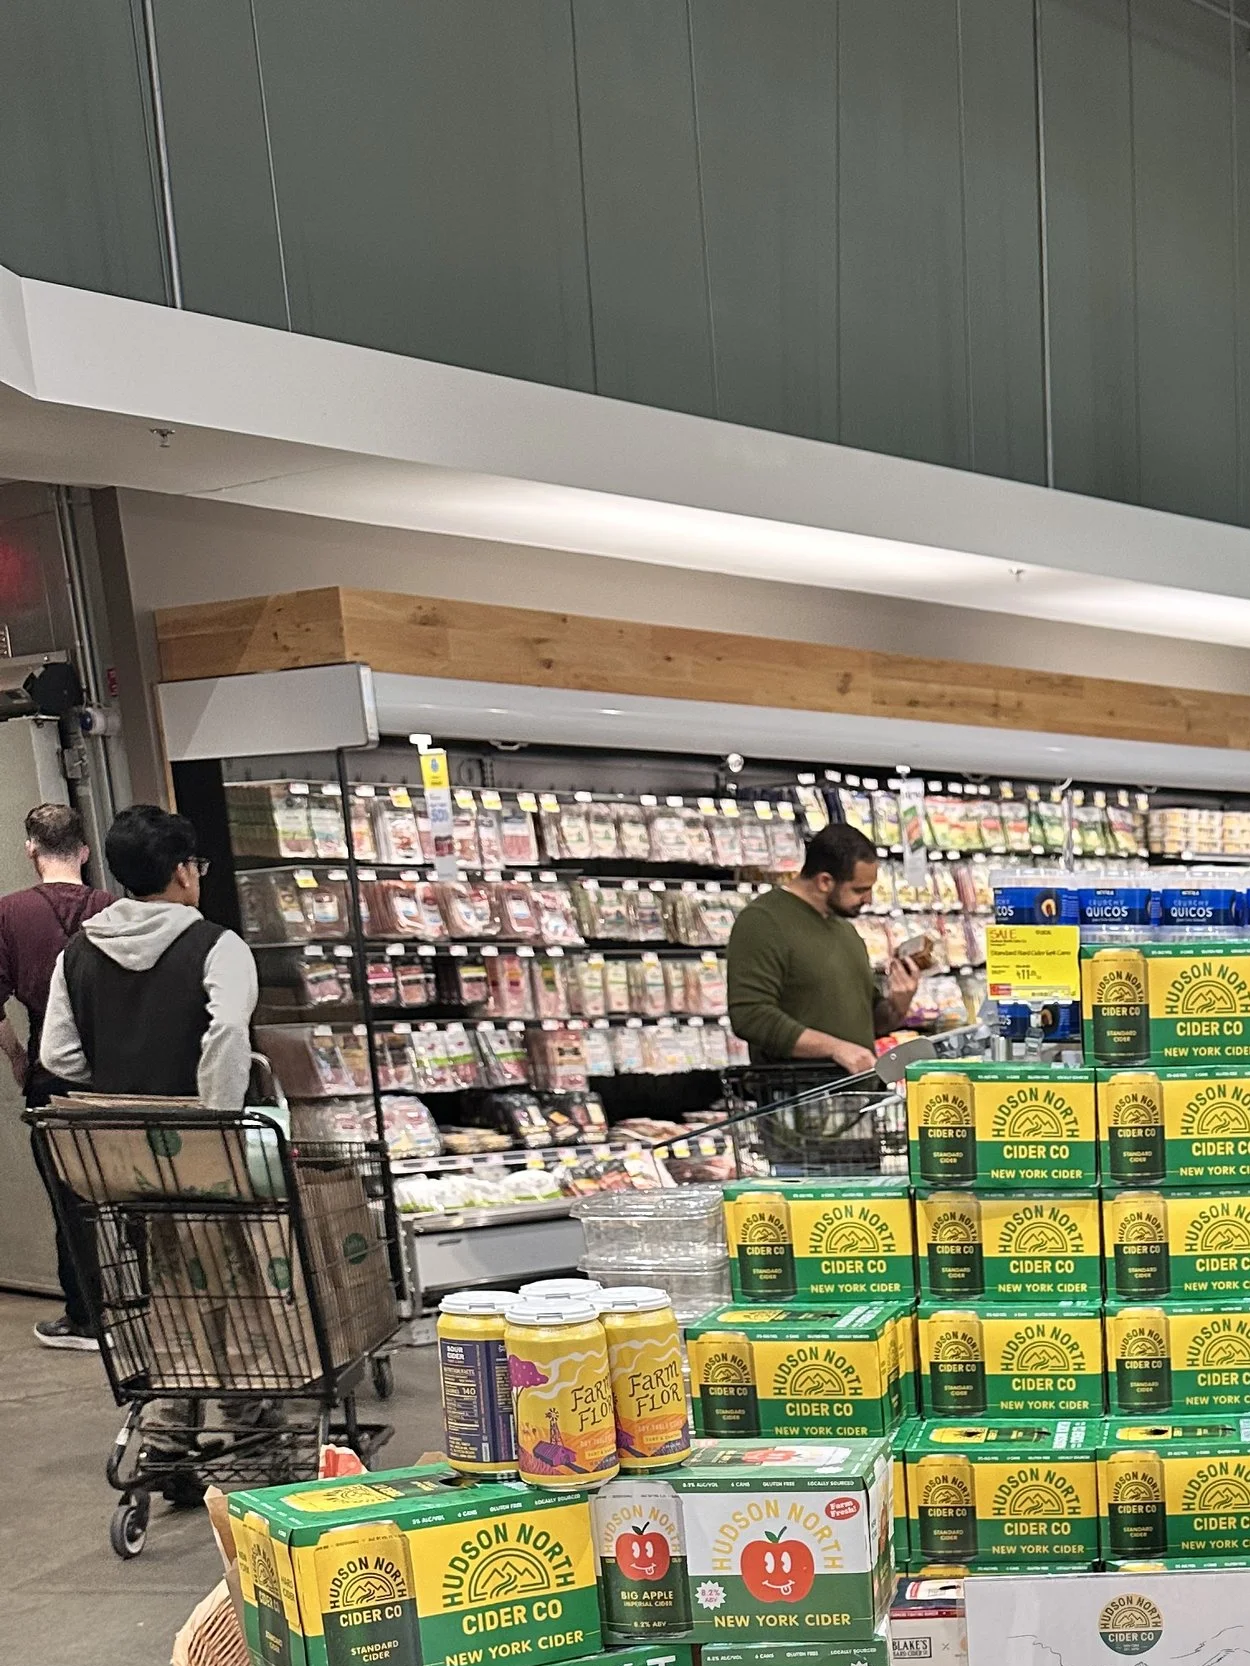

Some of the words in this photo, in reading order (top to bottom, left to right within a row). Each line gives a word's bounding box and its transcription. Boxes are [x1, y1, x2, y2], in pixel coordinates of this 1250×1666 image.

[1086, 907, 1129, 918] QUICOS
[1170, 907, 1213, 918] QUICOS
[1097, 971, 1122, 1002] HUDSON
[1125, 974, 1144, 1002] NORTH
[1165, 962, 1212, 1014] HUDSON
[1102, 1007, 1127, 1016] CIDER
[1129, 1006, 1140, 1016] CO
[1176, 1022, 1220, 1036] CIDER
[1223, 1021, 1243, 1035] CO
[1164, 1047, 1189, 1057] NEW
[1192, 1047, 1221, 1056] YORK
[462, 1387, 476, 1396] 140
[636, 1384, 682, 1417] FLOR
[830, 1500, 849, 1510] Farm
[712, 1500, 780, 1571] HUDSON
[788, 1502, 844, 1569] NORTH
[443, 1522, 508, 1608] HUDSON
[516, 1523, 576, 1588] NORTH
[330, 1556, 369, 1609] HUDSON
[374, 1556, 408, 1598] NORTH
[621, 1591, 640, 1601] BIG
[642, 1591, 673, 1600] APPLE
[339, 1608, 382, 1628] CIDER
[385, 1604, 403, 1619] CO
[462, 1606, 528, 1636] CIDER
[533, 1599, 563, 1622] CO
[1100, 1596, 1133, 1629] HUDSON
[1136, 1597, 1161, 1627] NORTH
[714, 1616, 749, 1628] NEW
[756, 1614, 799, 1627] YORK
[805, 1614, 851, 1626] CIDER
[1108, 1634, 1138, 1642] CIDER
[1141, 1632, 1154, 1641] CO
[350, 1640, 400, 1656] STANDARD
[488, 1639, 533, 1660] YORK
[537, 1630, 584, 1650] CIDER
[362, 1650, 391, 1663] CIDER
